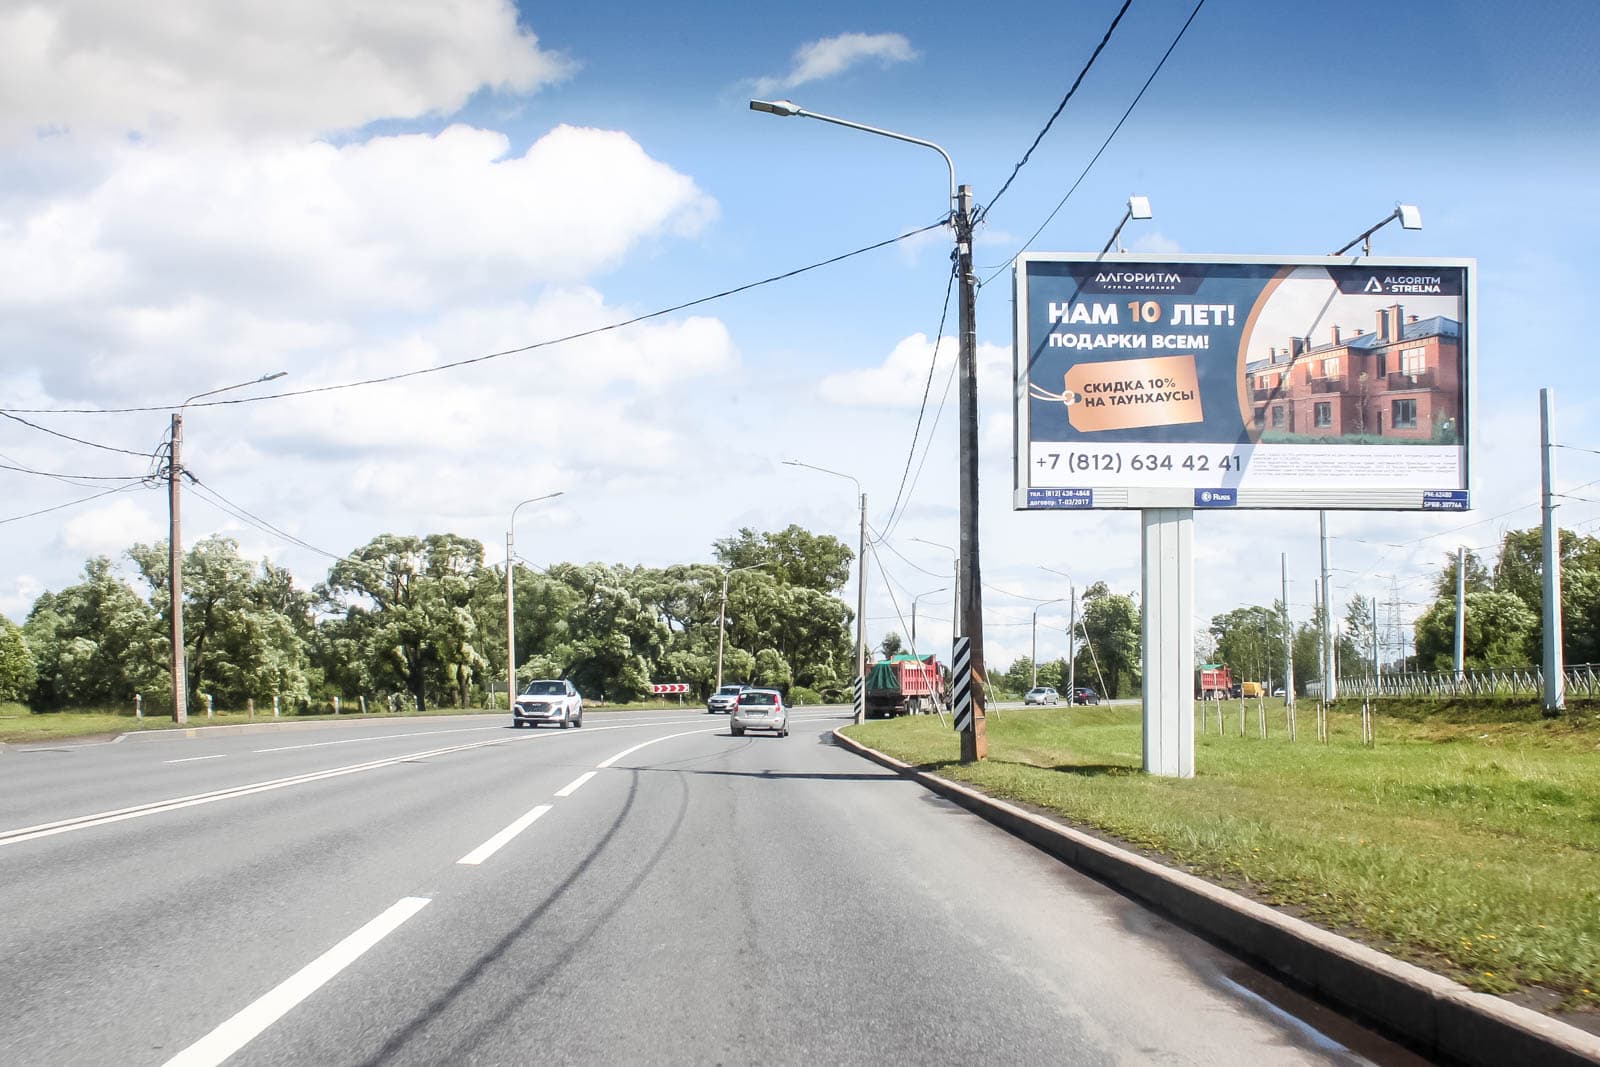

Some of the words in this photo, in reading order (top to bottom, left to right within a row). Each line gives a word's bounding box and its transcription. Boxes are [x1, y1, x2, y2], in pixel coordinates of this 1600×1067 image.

[1095, 272, 1182, 283] АЛГОРИТМ
[1384, 276, 1440, 285] ALGORITM
[1391, 284, 1440, 293] STRELNA
[1048, 302, 1119, 325] НАМ
[1127, 301, 1162, 323] 10
[1170, 304, 1236, 326] ЛЕТ!
[1049, 333, 1147, 350] ПОДАРКИ
[1151, 335, 1210, 350] ВСЕМ!
[1083, 381, 1145, 394] СКИДКА
[1148, 378, 1176, 389] 10%
[1085, 397, 1105, 408] НА
[1110, 390, 1194, 406] ТАУНХАУСЫ
[1036, 453, 1060, 470] +7
[1068, 452, 1122, 473] (812)
[1131, 454, 1174, 471] 634
[1182, 454, 1210, 471] 42
[1218, 455, 1241, 472] 41
